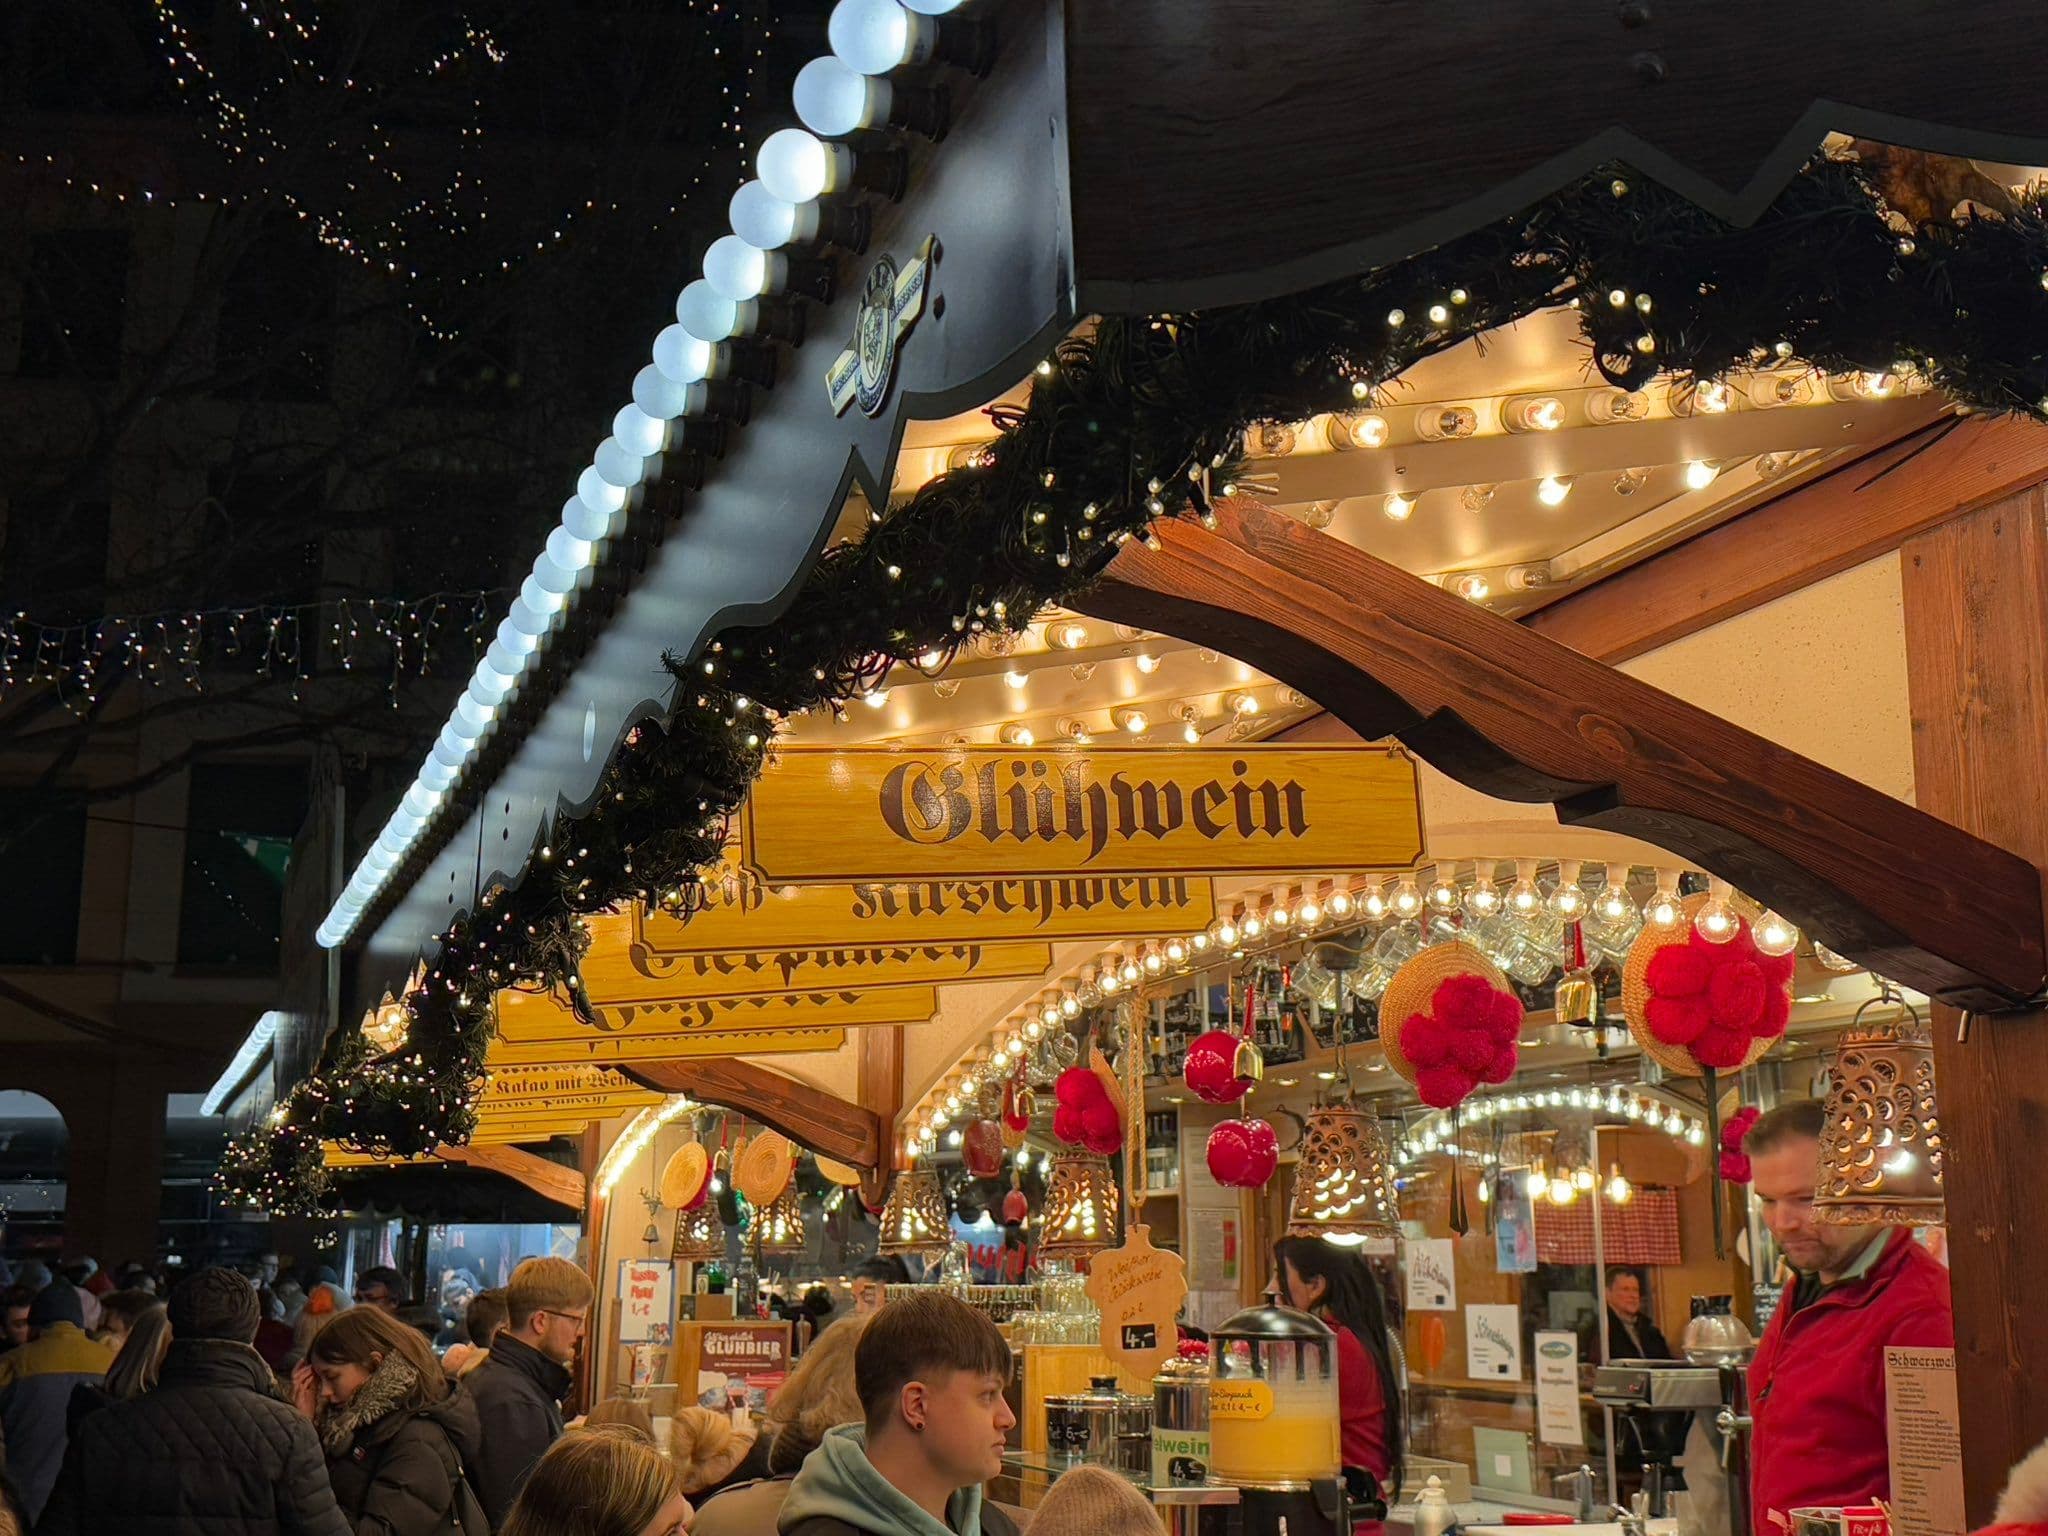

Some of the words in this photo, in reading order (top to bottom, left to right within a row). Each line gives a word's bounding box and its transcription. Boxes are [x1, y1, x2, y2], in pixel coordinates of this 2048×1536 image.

[878, 758, 1312, 867] Glühwein
[496, 1078, 550, 1095] Kakao
[554, 1076, 582, 1091] mit
